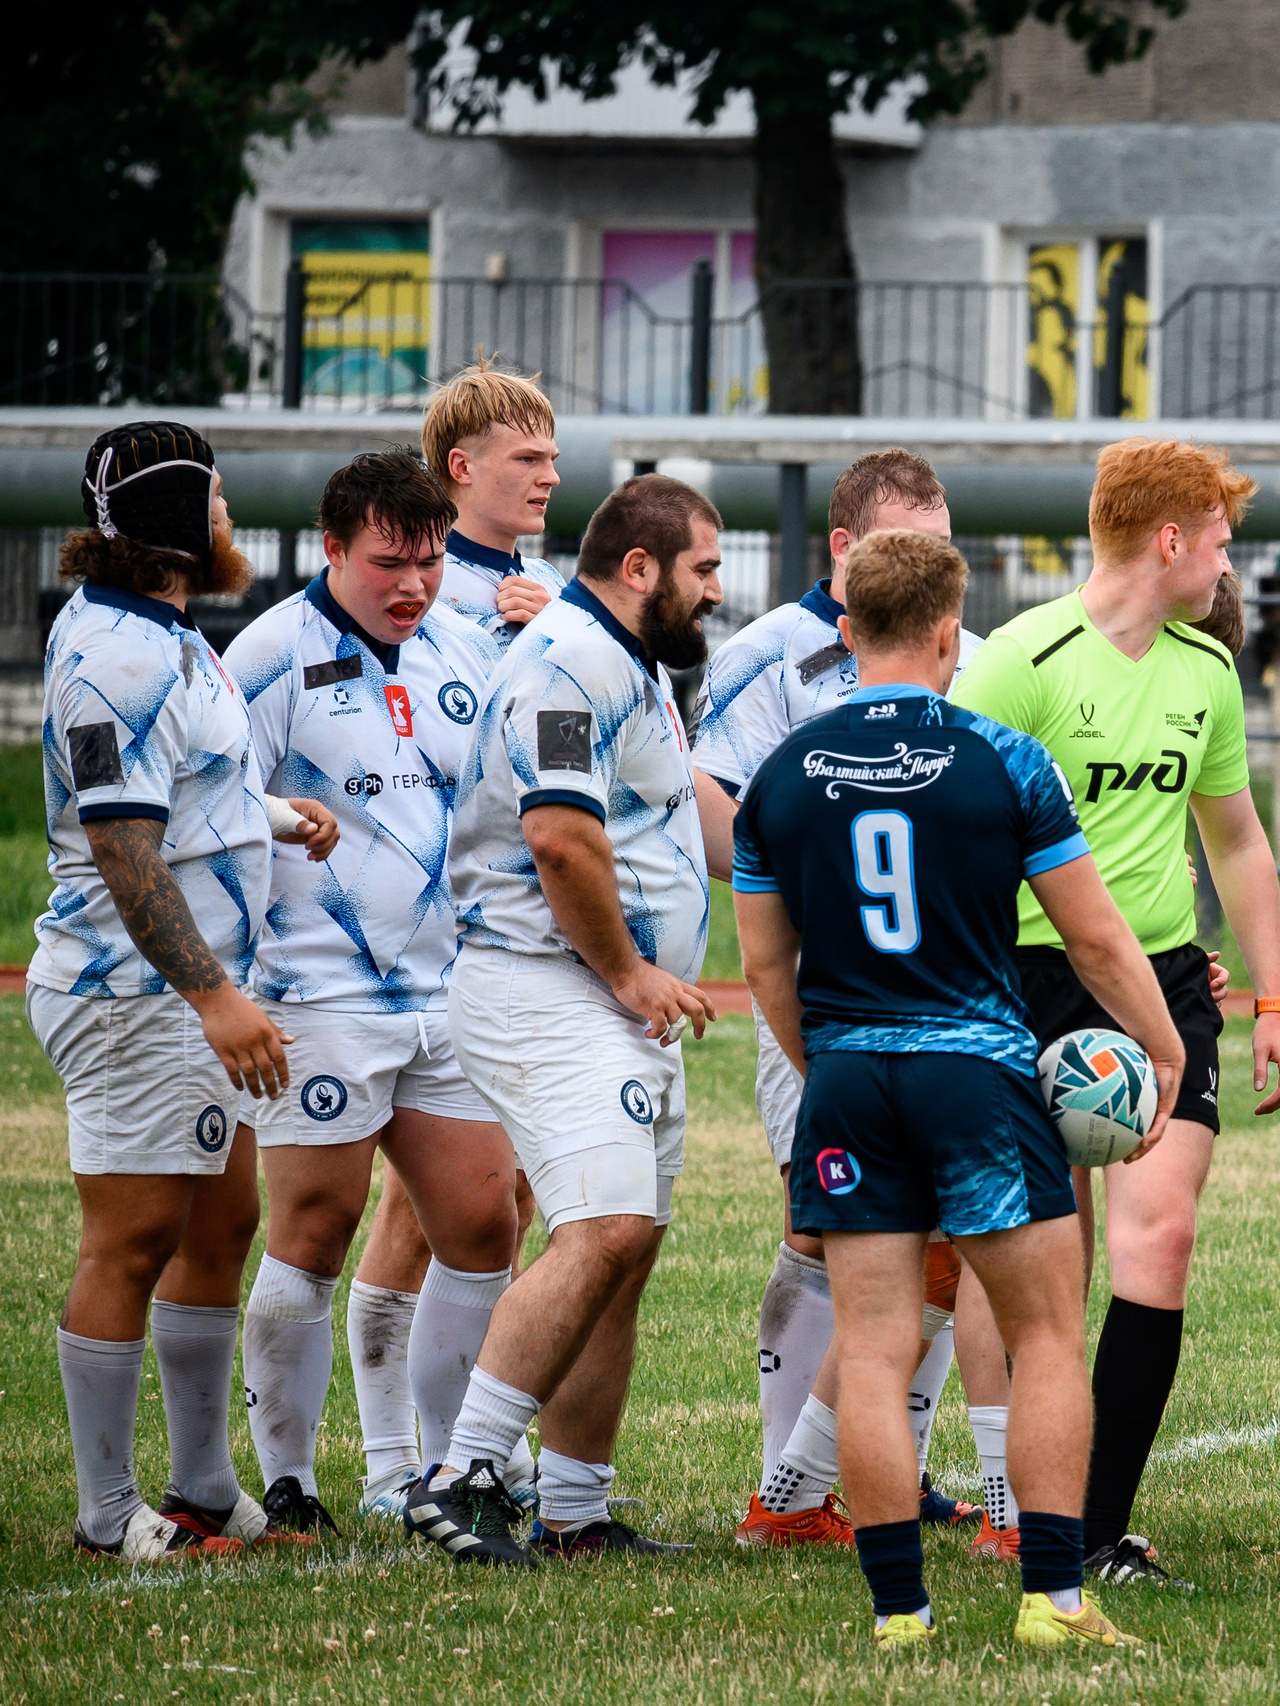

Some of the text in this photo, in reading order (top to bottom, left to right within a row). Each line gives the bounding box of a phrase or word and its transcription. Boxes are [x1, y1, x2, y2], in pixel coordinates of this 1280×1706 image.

[329, 706, 362, 717] centurion
[1069, 728, 1105, 738] JÖGEL
[803, 742, 907, 781] Балтийский
[851, 809, 921, 953] 9
[469, 1479, 495, 1487] adidas
